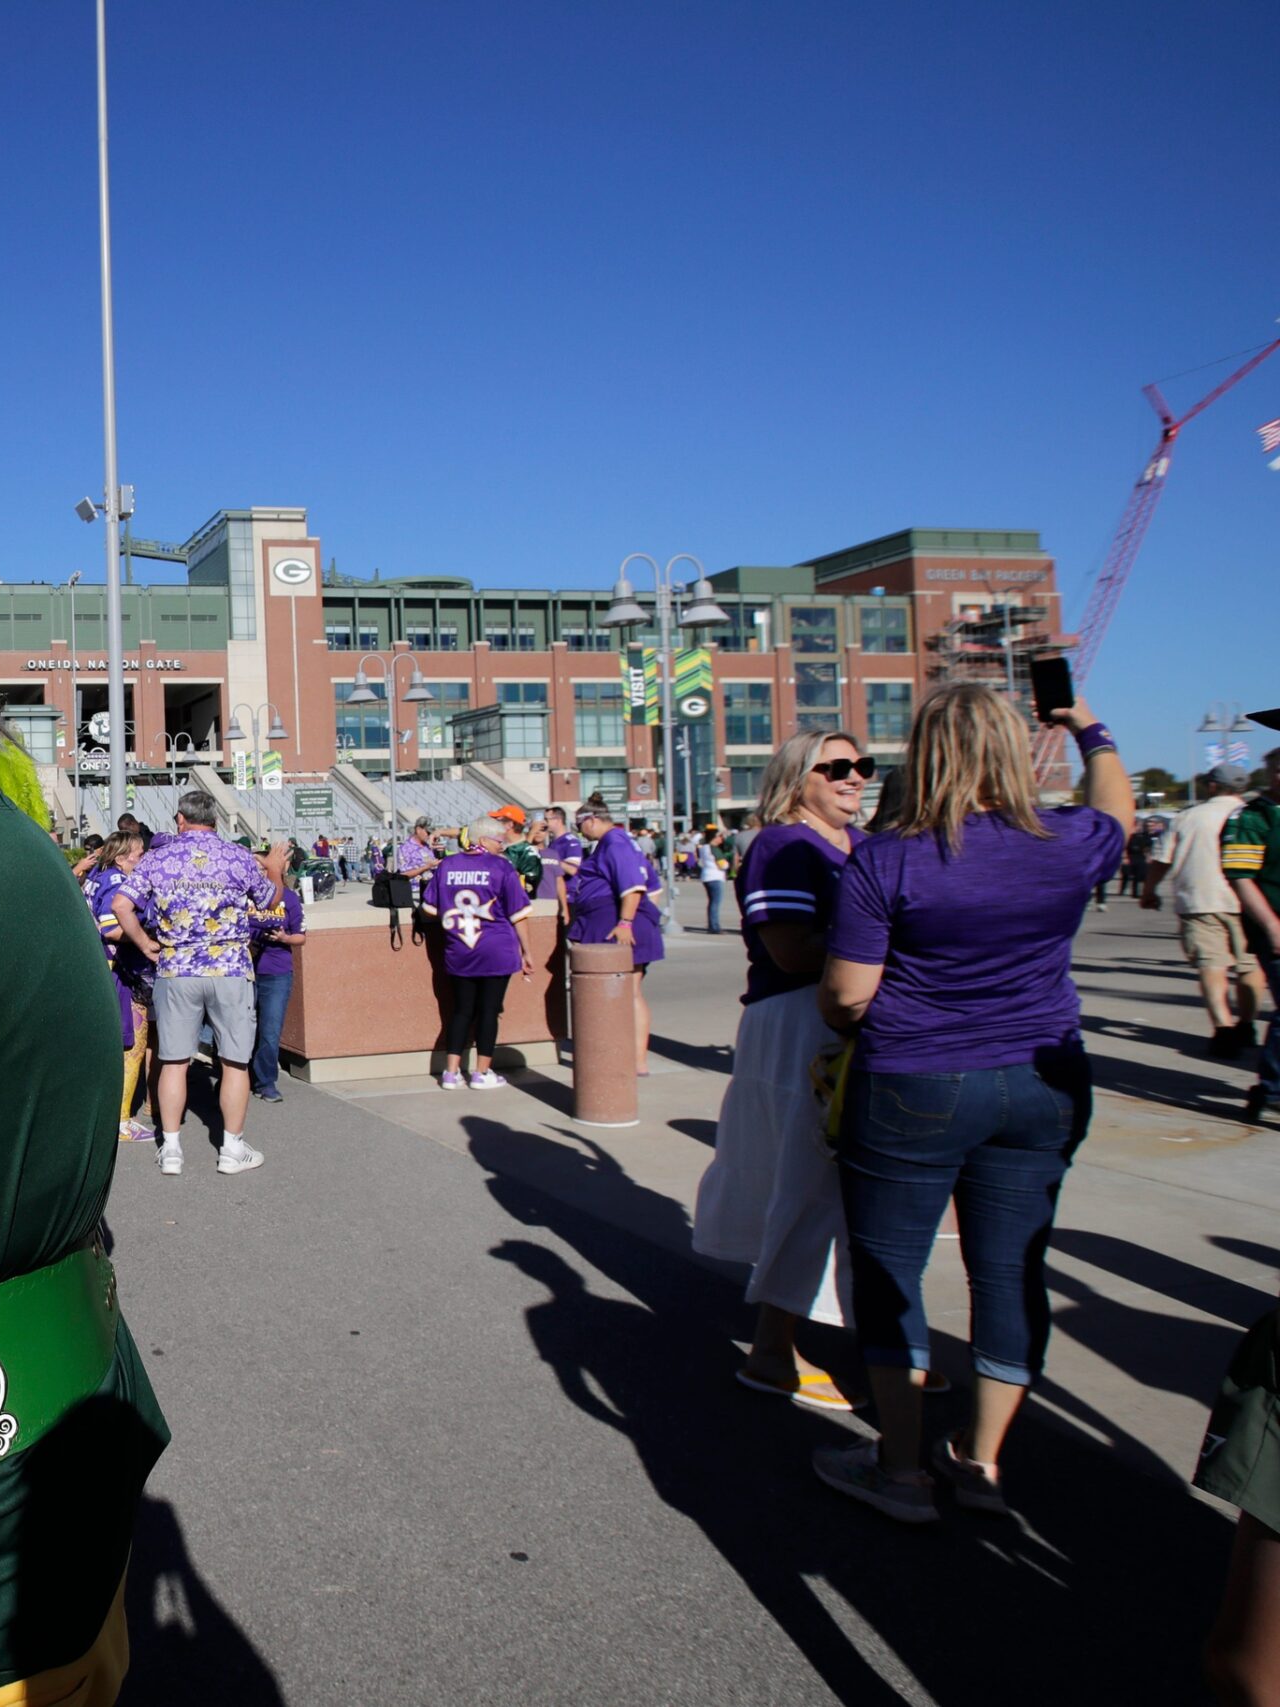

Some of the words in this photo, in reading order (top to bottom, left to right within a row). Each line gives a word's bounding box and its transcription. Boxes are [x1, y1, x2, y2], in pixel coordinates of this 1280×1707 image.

[27, 659, 80, 669] ONEIDA
[88, 659, 139, 669] NAON
[146, 659, 181, 669] GATE
[629, 666, 646, 707] VISIT
[237, 756, 245, 786] PASSION
[446, 871, 490, 886] PRINCE
